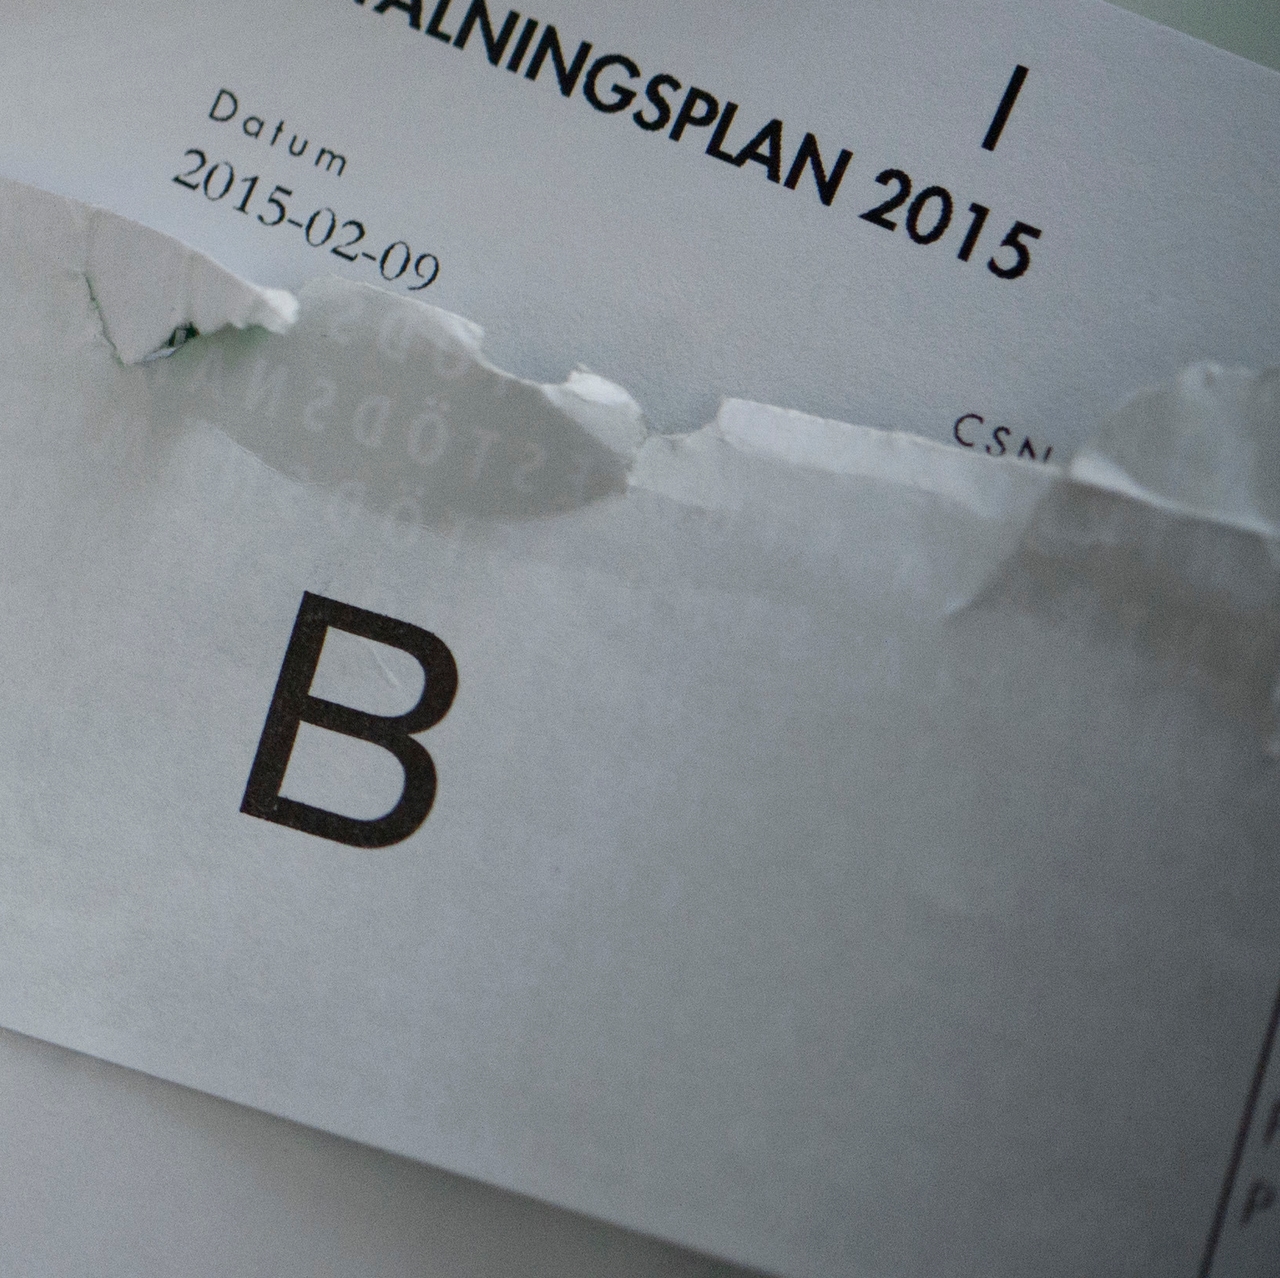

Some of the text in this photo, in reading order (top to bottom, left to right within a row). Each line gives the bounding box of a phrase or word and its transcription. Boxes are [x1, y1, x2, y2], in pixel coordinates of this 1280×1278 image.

[208, 88, 348, 177] Datum
[172, 148, 441, 293] 2015-02-09
[858, 167, 1043, 281] 2015
[239, 590, 459, 850] B
